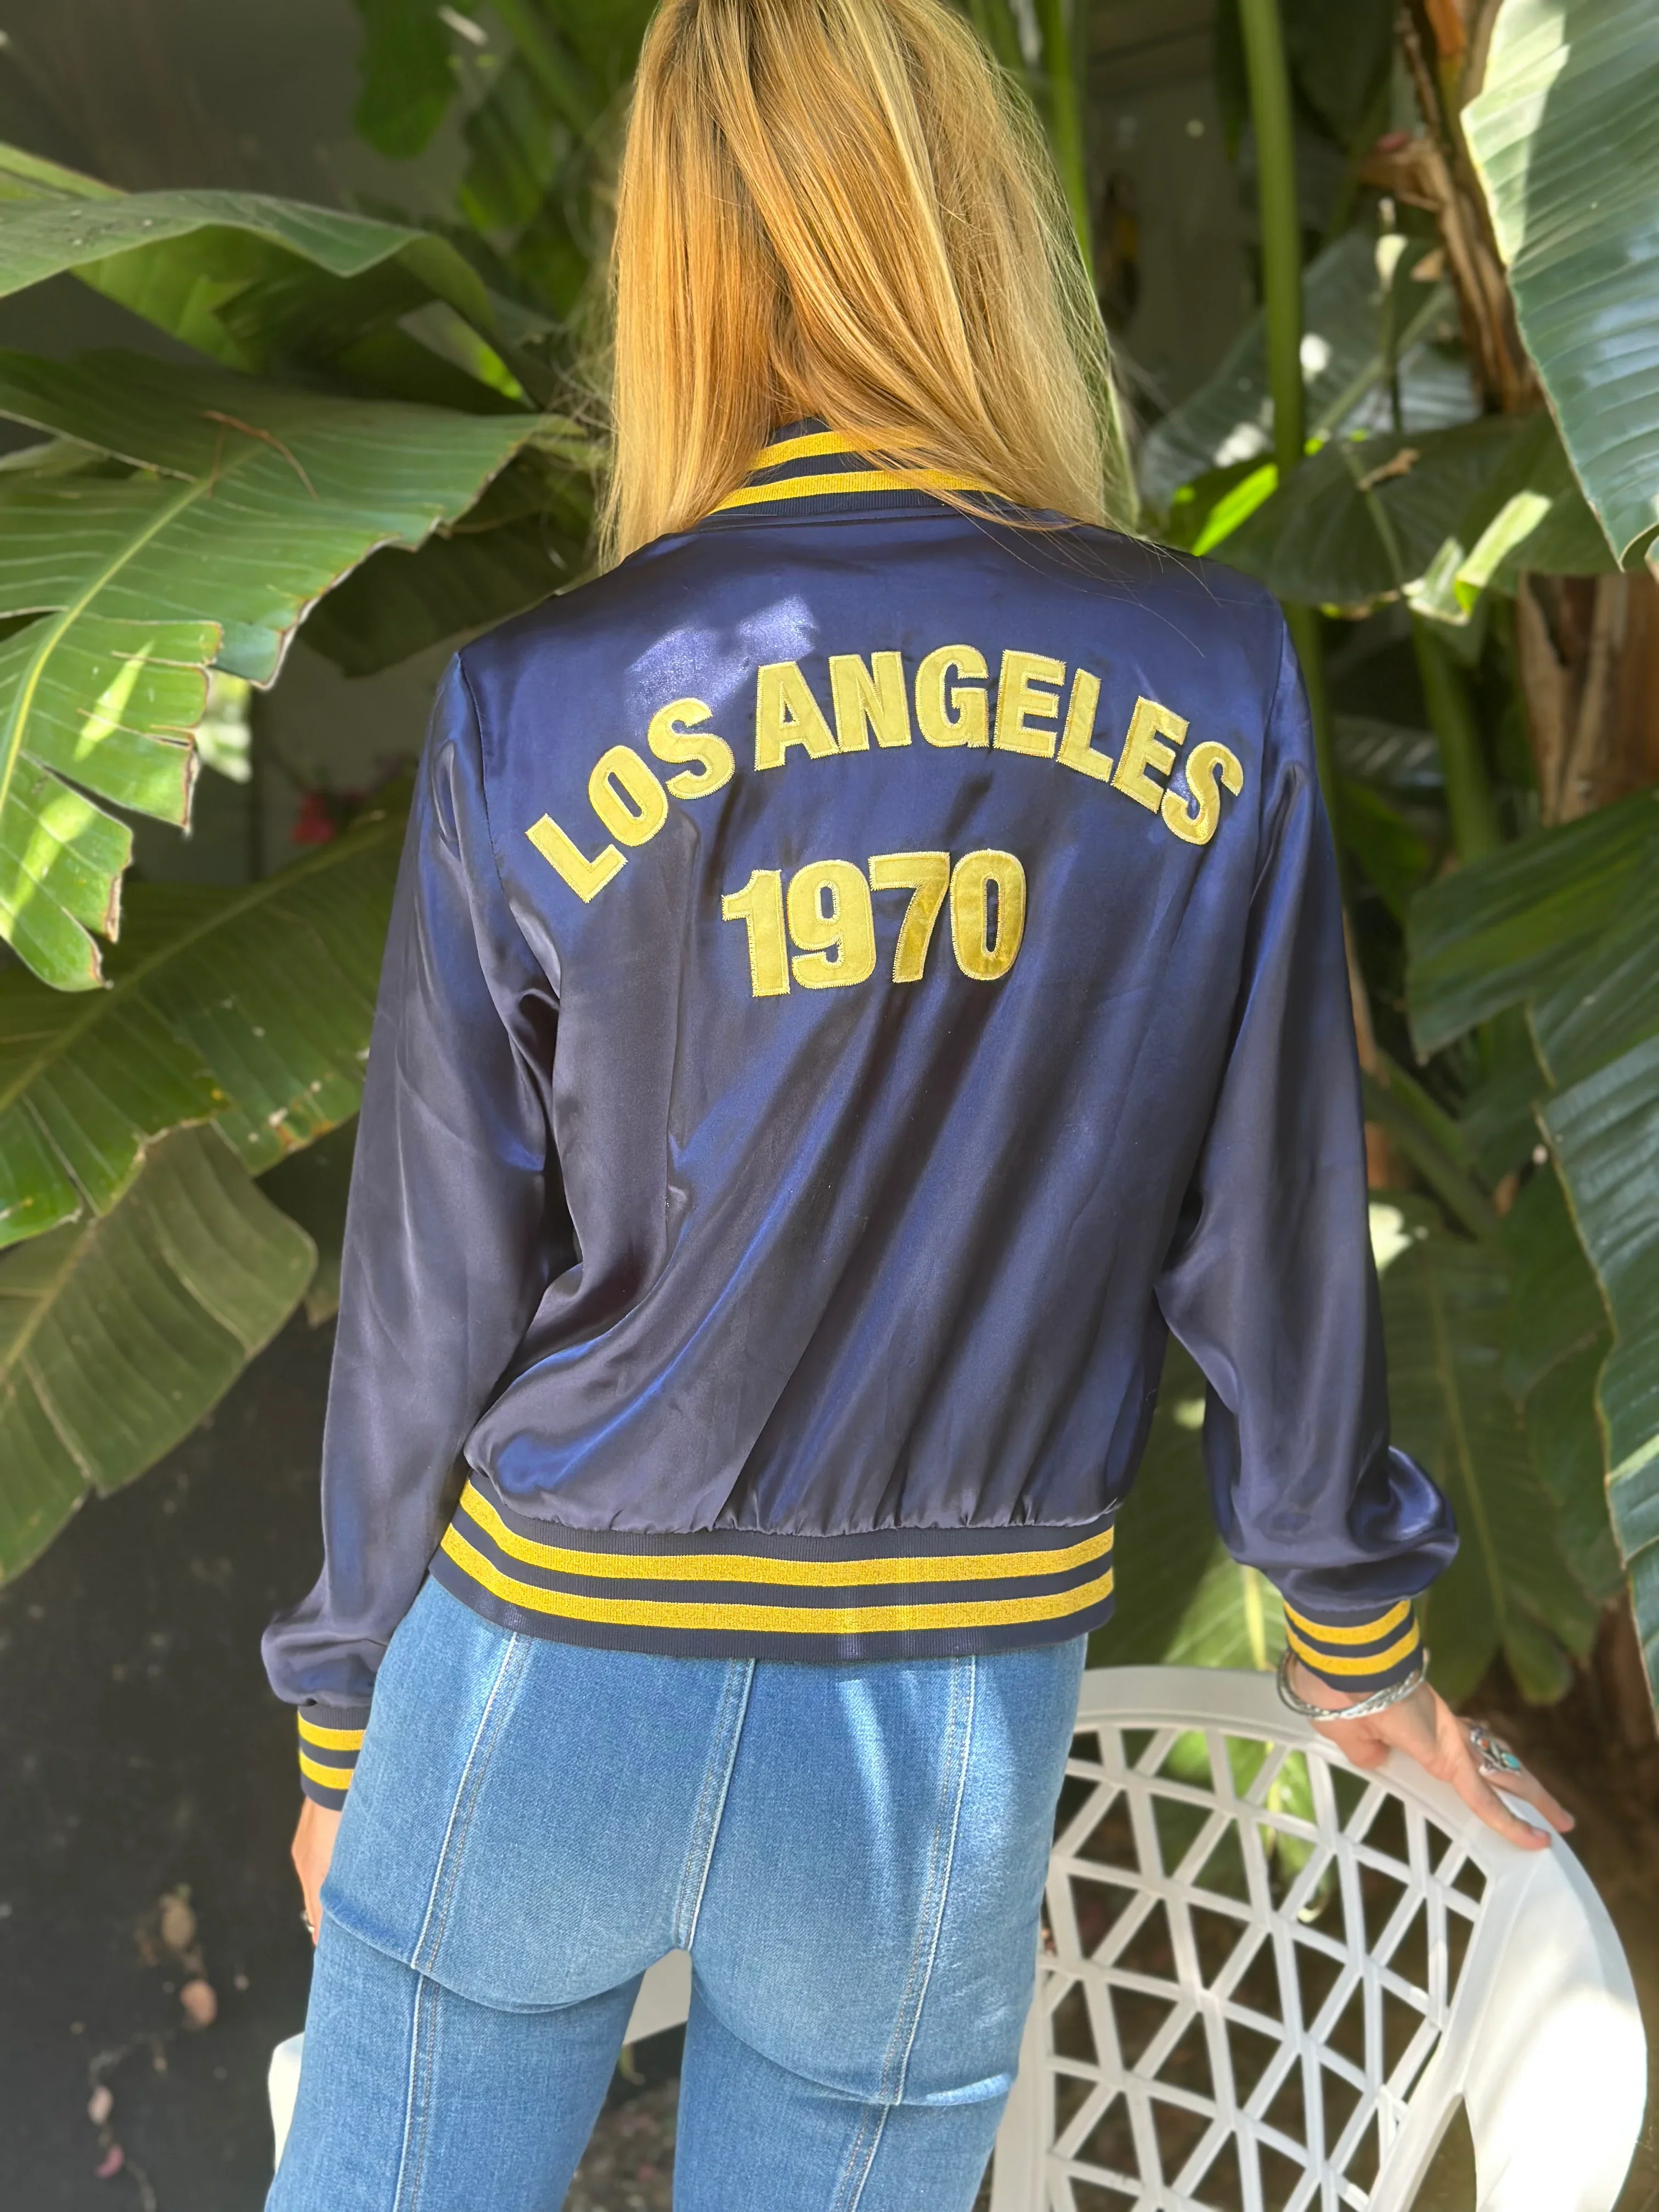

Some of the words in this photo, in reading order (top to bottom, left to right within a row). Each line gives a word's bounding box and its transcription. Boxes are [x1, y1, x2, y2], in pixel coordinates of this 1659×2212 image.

[525, 698, 735, 903] LOS
[754, 645, 1244, 845] ANGELES
[721, 849, 1026, 998] 1970
